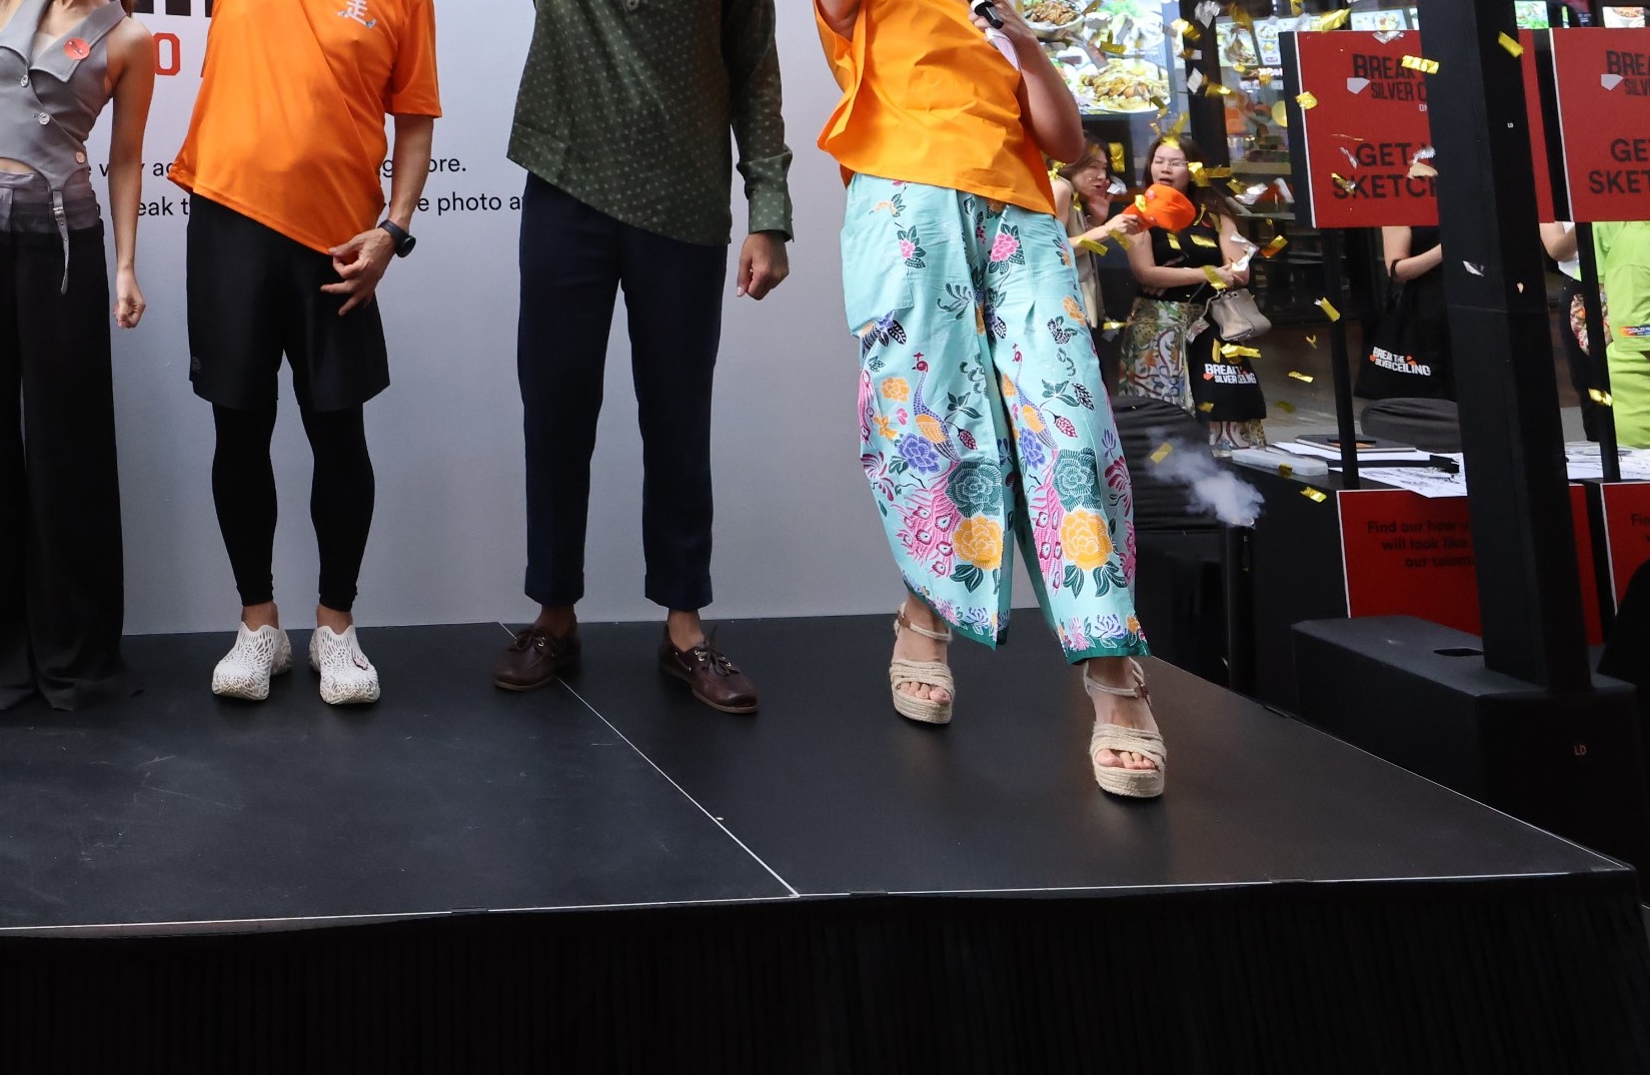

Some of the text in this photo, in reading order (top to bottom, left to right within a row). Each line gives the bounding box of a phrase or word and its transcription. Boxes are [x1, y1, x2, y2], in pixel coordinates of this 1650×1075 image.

[1370, 80, 1414, 102] SILVER
[1355, 142, 1412, 167] GET
[437, 192, 502, 216] photo
[1392, 362, 1431, 376] CEILING
[1367, 520, 1397, 534] Find
[1382, 537, 1467, 551] will look like
[1405, 557, 1427, 568] our
